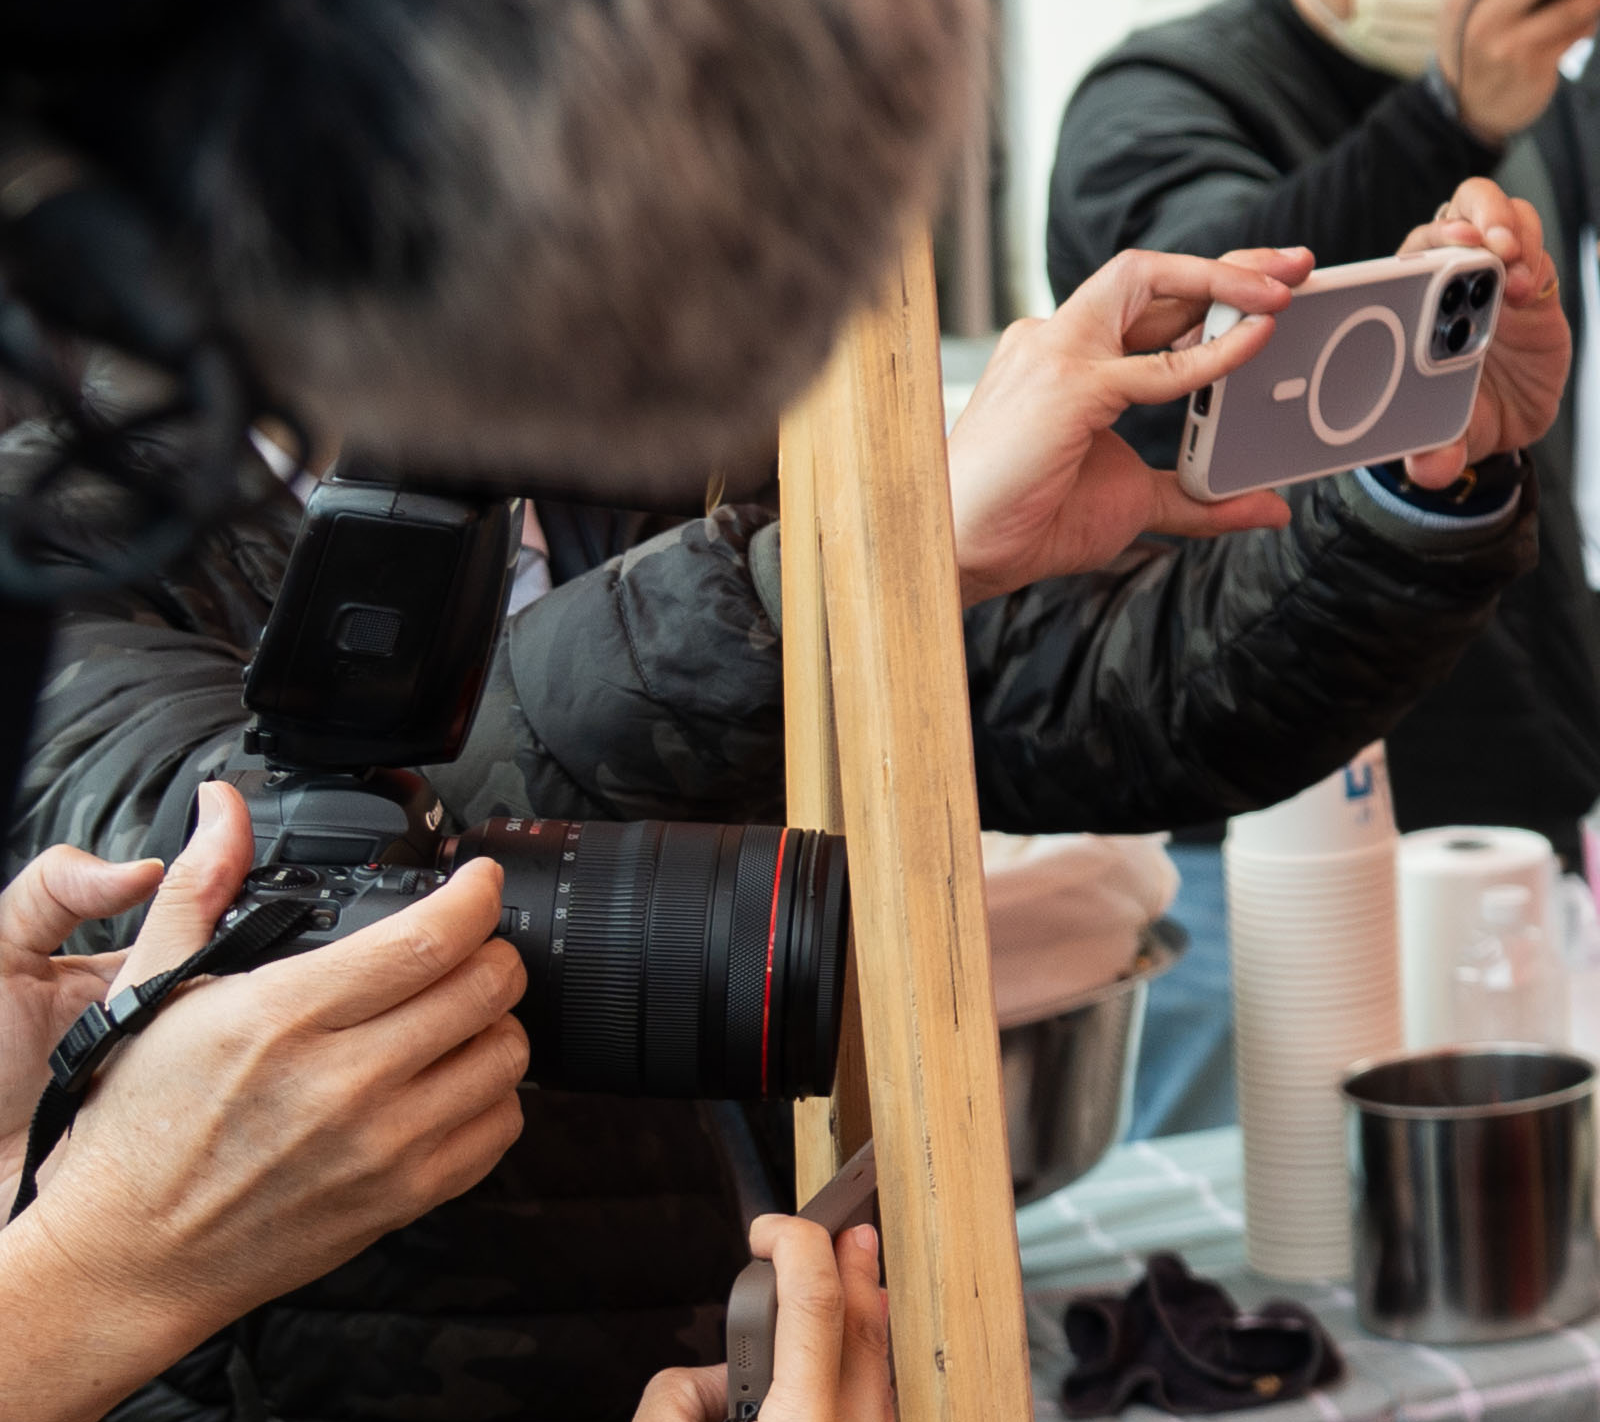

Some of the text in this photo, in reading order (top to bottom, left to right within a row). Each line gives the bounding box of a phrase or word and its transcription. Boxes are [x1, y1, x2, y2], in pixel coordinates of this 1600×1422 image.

[558, 882, 570, 893] 70
[555, 908, 567, 919] 85
[520, 911, 530, 931] LOCK
[552, 939, 564, 954] 105
